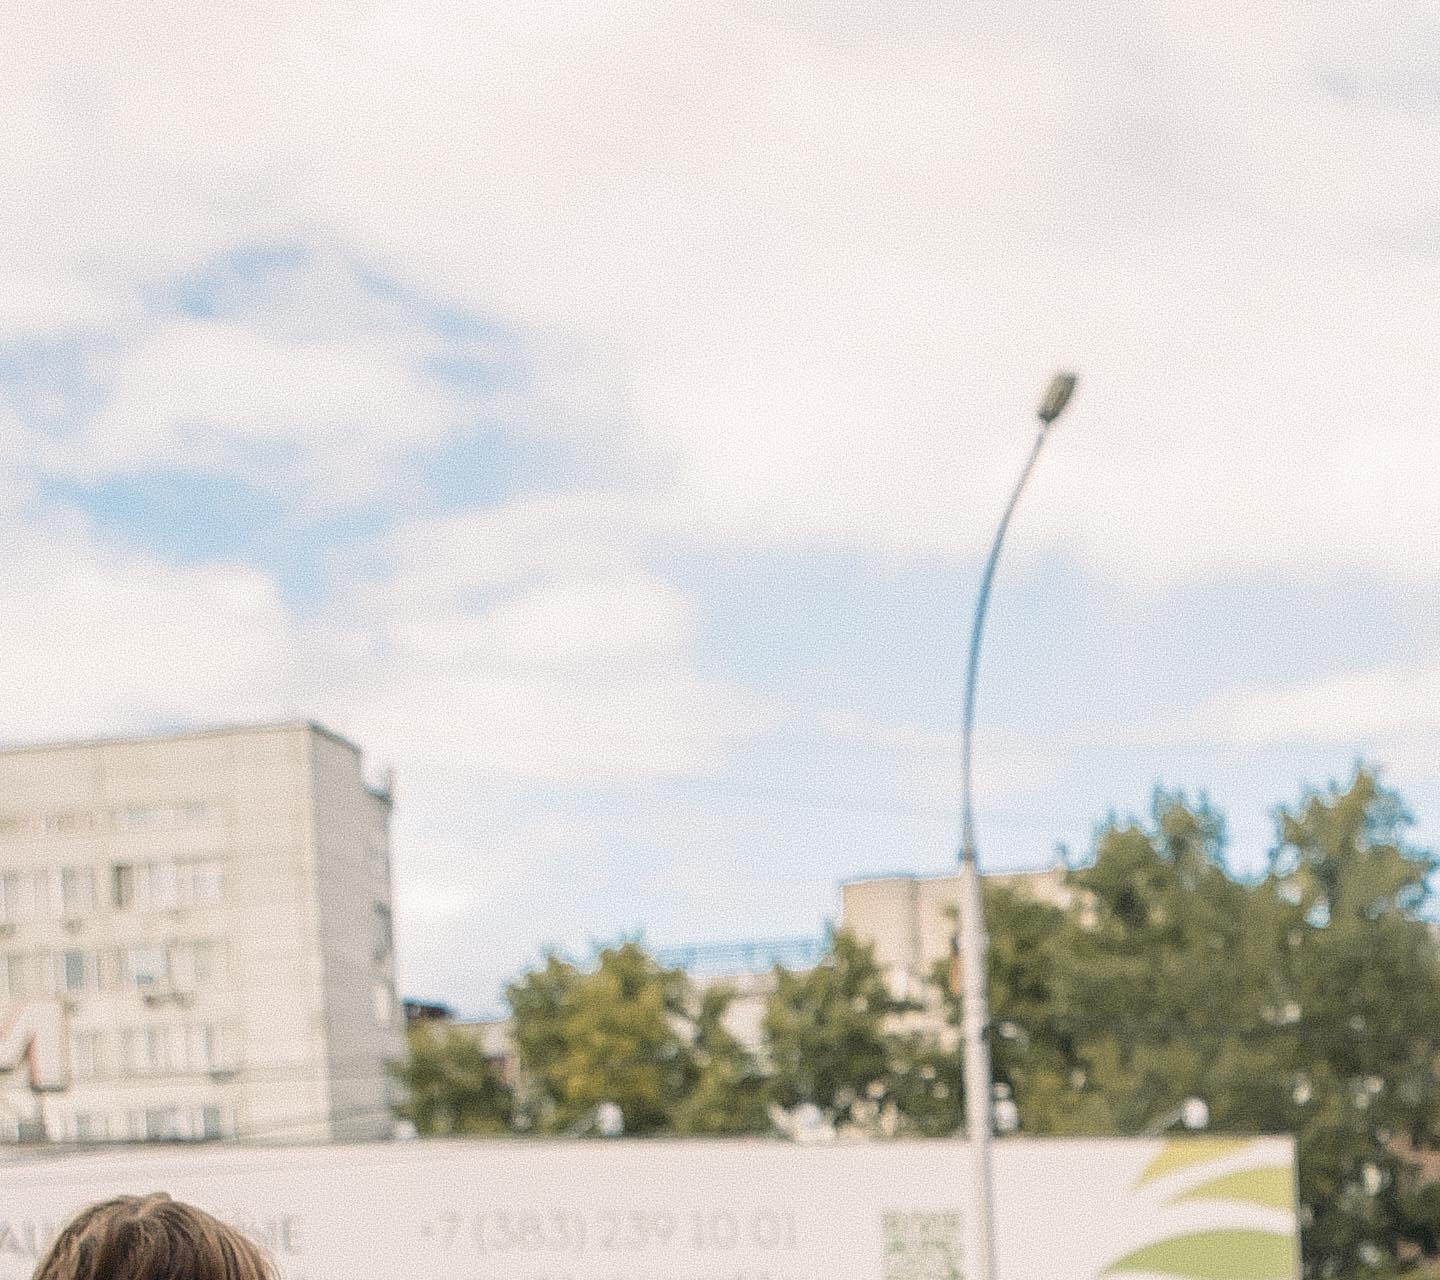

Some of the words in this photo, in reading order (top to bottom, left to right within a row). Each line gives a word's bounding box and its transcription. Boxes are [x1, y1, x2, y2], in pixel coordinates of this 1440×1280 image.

[471, 1207, 589, 1258] (383)
[596, 1208, 678, 1250] 239
[690, 1208, 740, 1250] 10
[749, 1207, 799, 1250] 01
